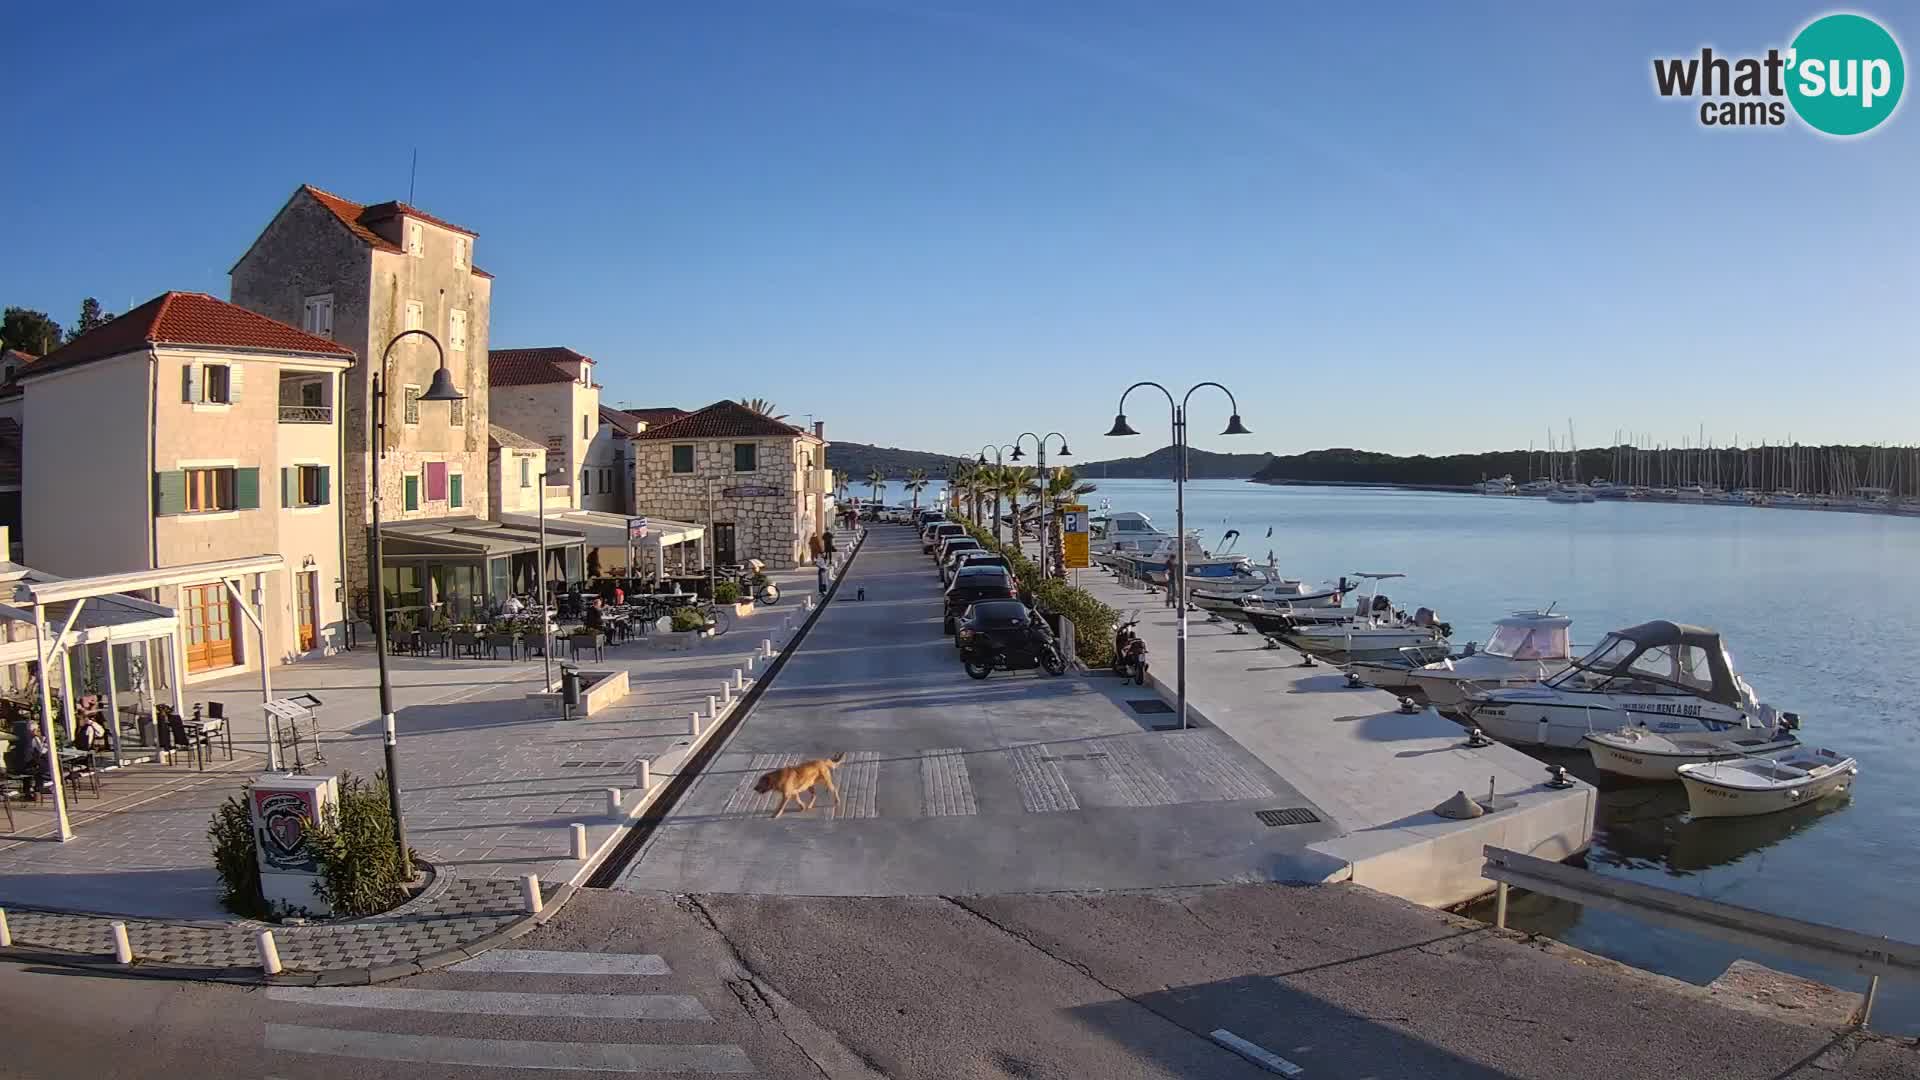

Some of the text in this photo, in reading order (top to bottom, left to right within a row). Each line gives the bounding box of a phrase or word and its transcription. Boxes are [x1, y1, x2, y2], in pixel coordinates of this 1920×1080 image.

[1065, 514, 1076, 531] P
[1656, 703, 1677, 714] RENT
[1676, 703, 1682, 714] A
[1683, 703, 1702, 716] BOAT
